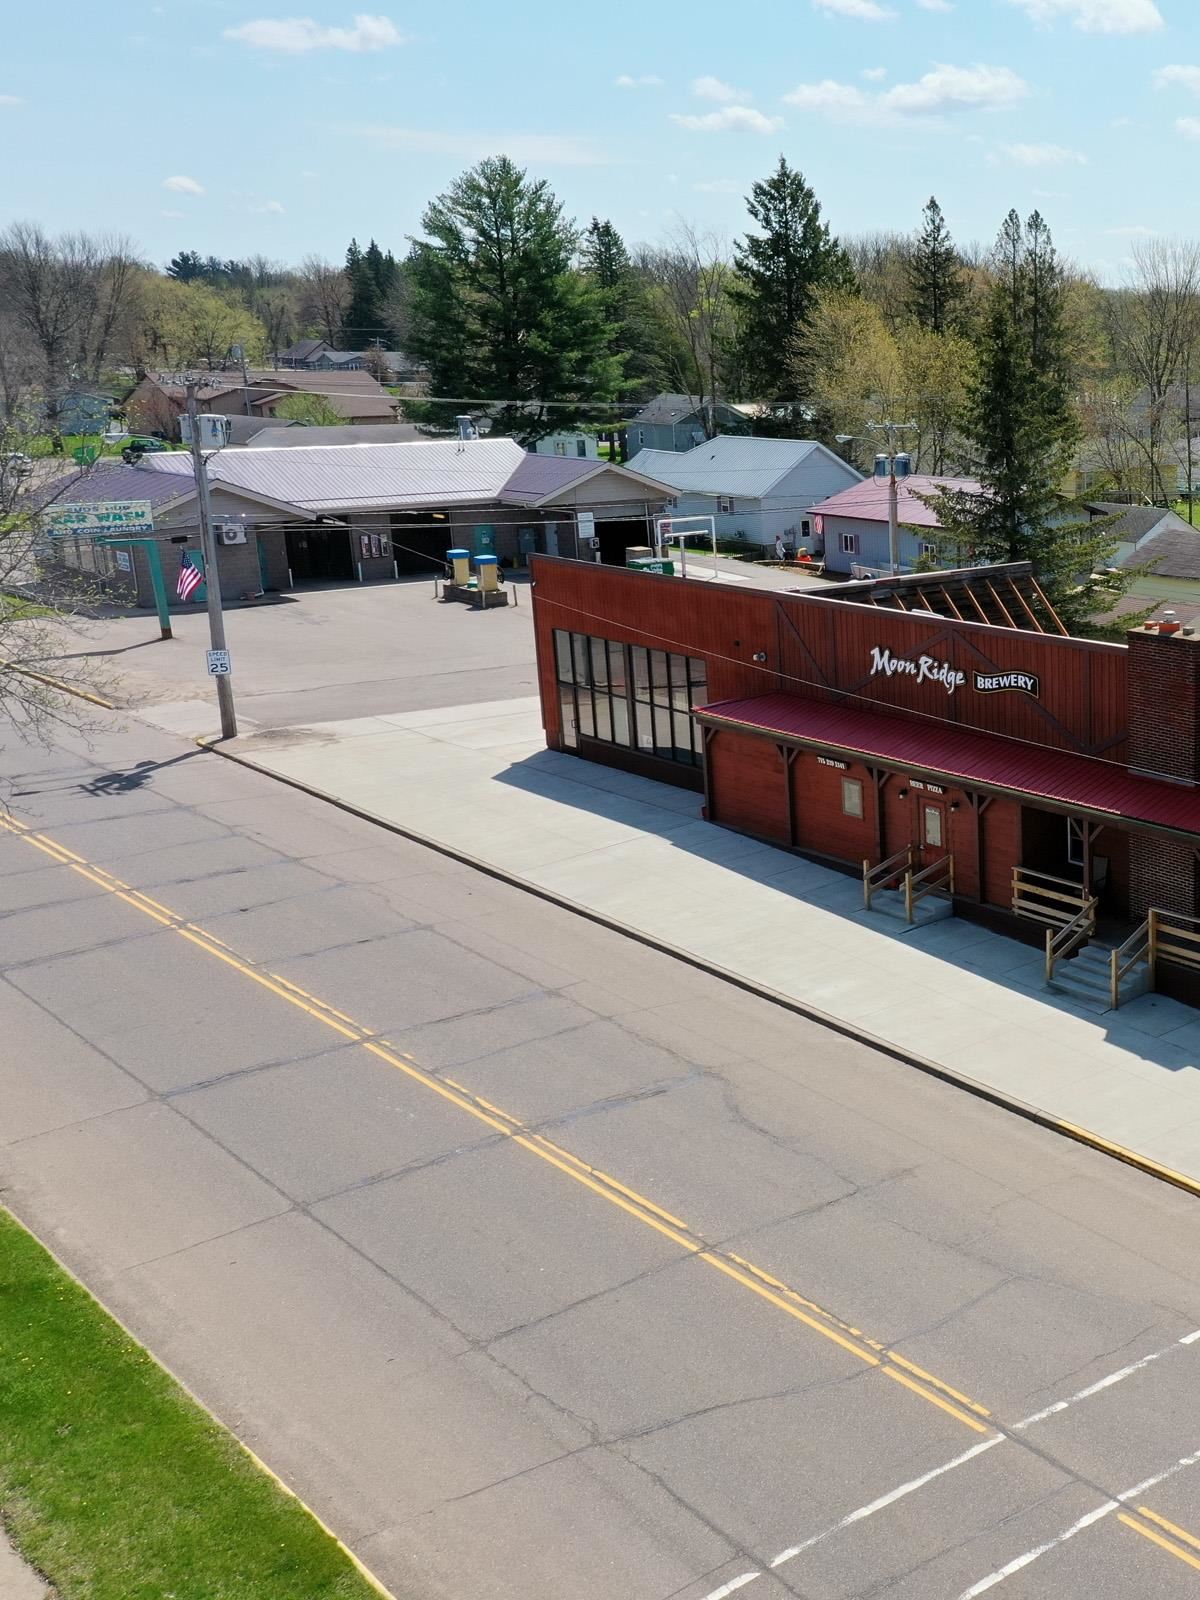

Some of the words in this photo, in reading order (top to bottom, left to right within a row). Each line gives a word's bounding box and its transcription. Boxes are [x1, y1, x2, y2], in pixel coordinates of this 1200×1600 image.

[95, 511, 145, 522] WASH
[103, 525, 147, 533] LAUNDRY
[210, 663, 228, 673] 25
[870, 647, 917, 676] Moon
[916, 655, 966, 694] Ridge
[976, 674, 1034, 691] BREWERY
[909, 779, 924, 790] BEER
[926, 784, 943, 794] PIZZA
